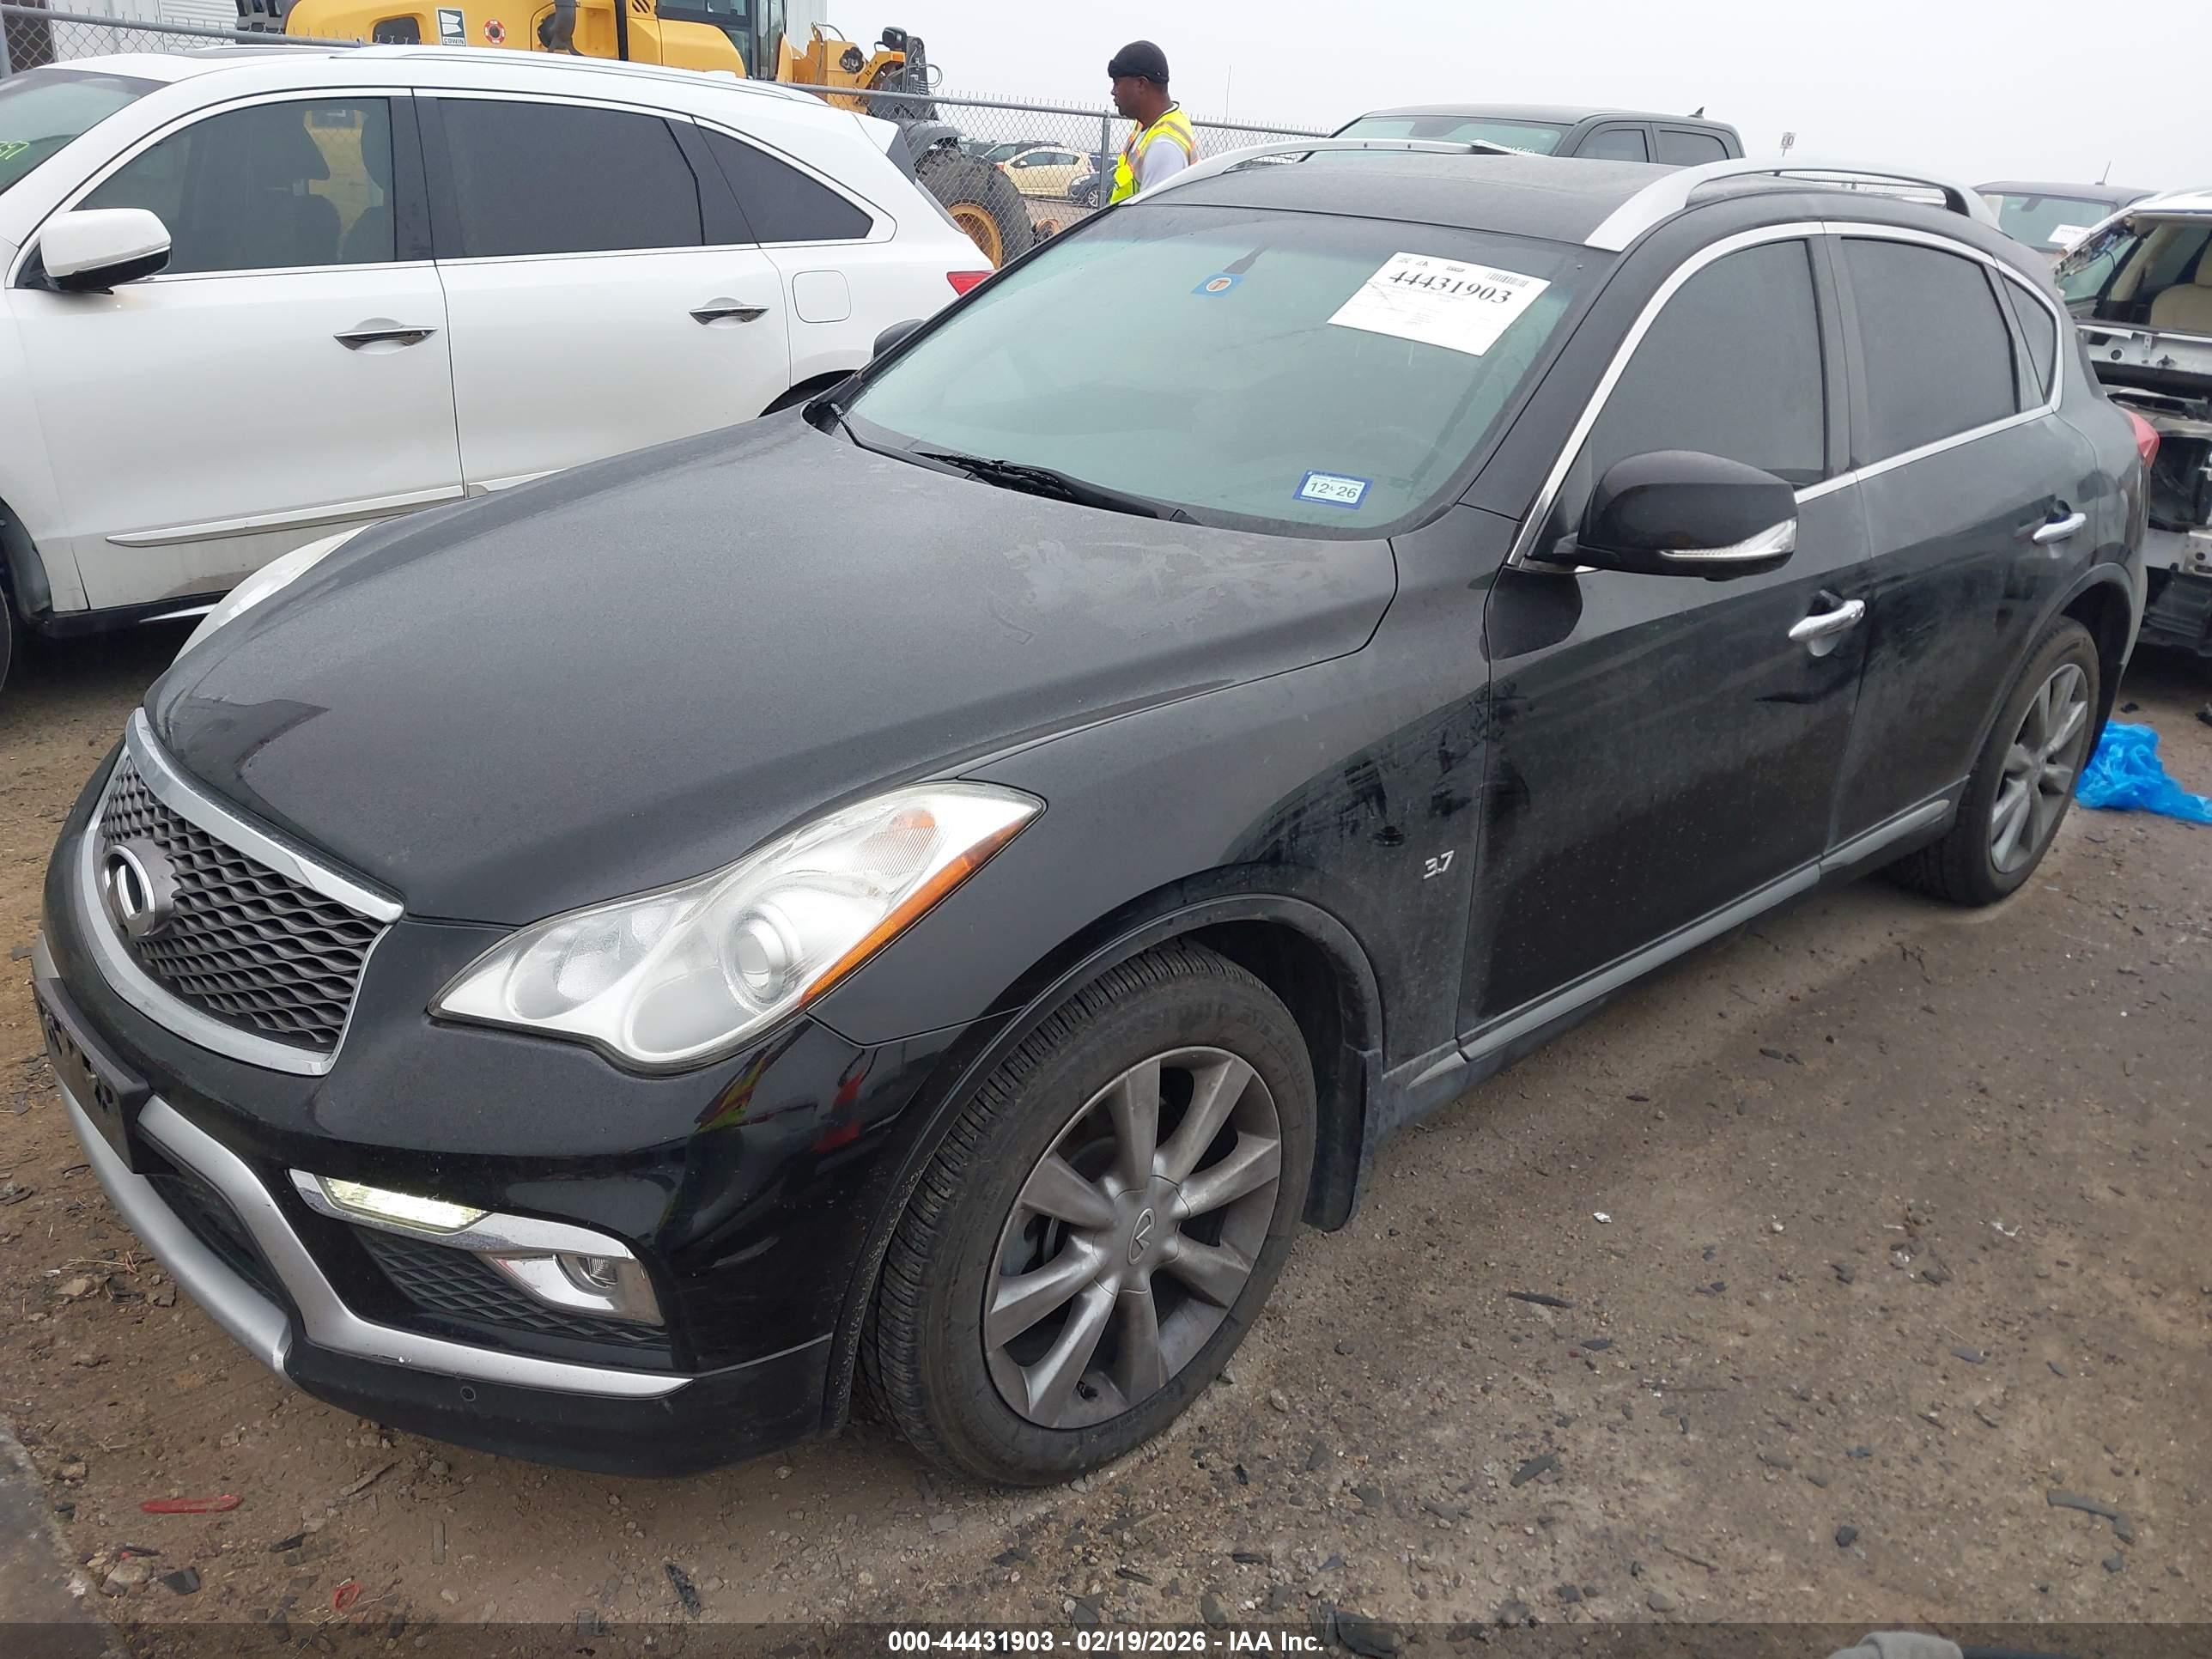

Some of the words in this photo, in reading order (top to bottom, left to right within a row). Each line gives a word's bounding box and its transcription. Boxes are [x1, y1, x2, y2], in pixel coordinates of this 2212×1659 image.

[1389, 270, 1513, 304] 44431903
[1310, 482, 1330, 495] 12
[1336, 486, 1358, 499] 26
[1423, 850, 1455, 880] 3.7
